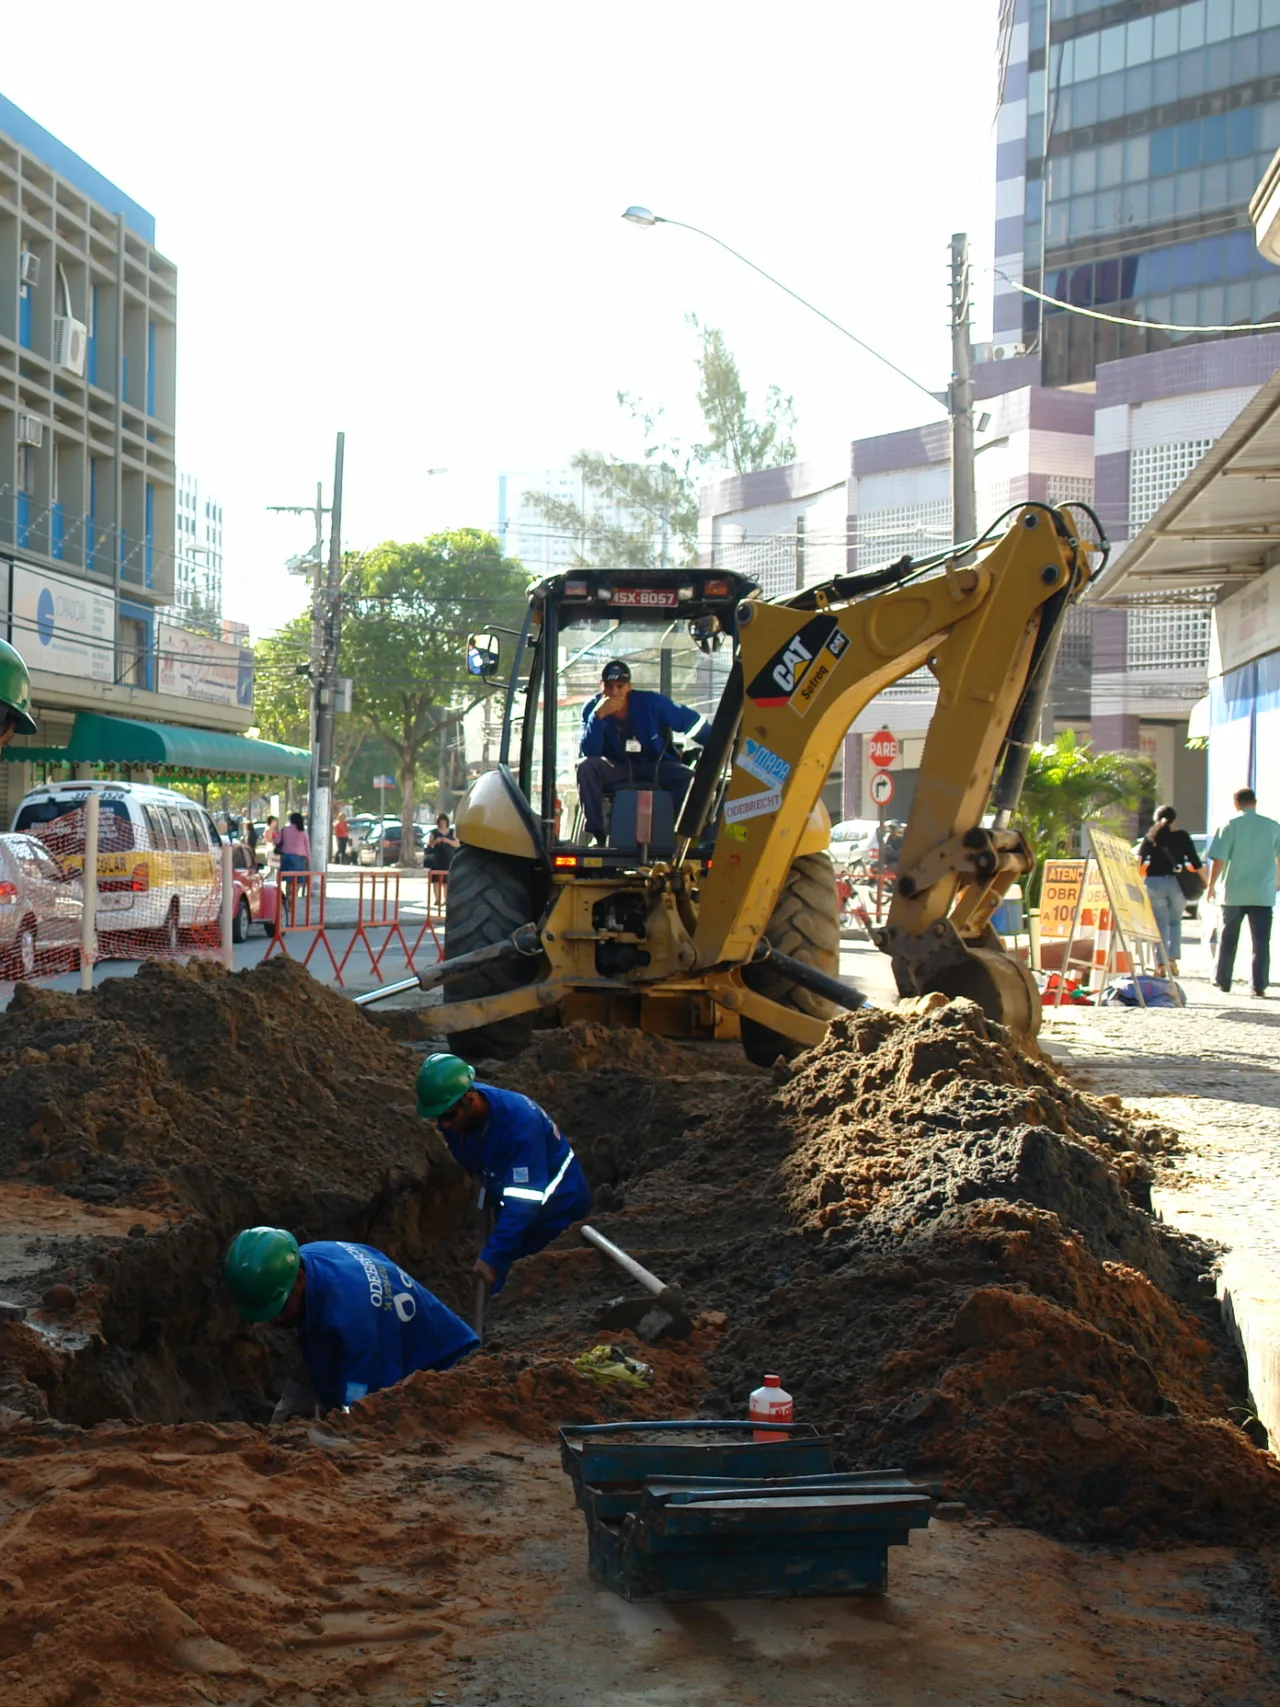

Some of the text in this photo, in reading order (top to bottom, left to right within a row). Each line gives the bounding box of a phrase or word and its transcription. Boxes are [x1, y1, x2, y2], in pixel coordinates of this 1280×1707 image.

[829, 632, 846, 655] CAT
[772, 634, 814, 692] CAT
[801, 664, 830, 701] Sotreq
[870, 741, 898, 757] PARE
[727, 794, 781, 818] ODEBRECHT
[1047, 888, 1077, 900] OBR
